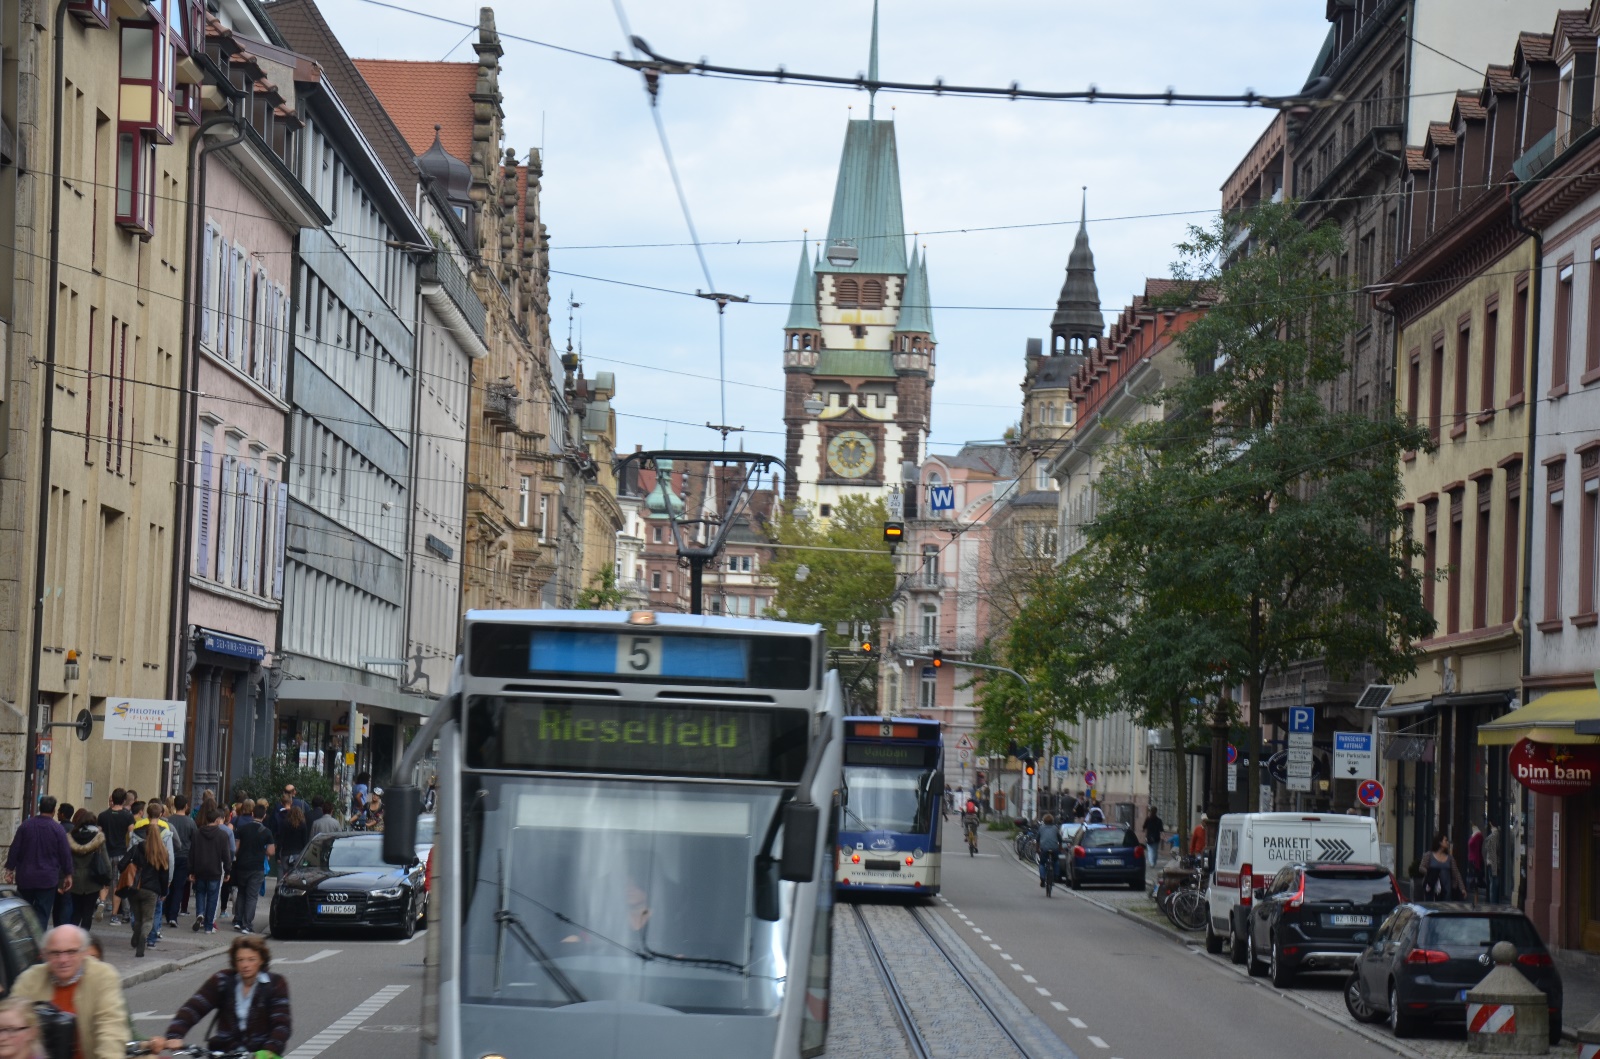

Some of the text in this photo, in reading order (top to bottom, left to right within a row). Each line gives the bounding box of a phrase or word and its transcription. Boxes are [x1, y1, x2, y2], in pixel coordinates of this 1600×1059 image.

[931, 489, 953, 507] W
[628, 637, 651, 671] 5
[112, 702, 165, 716] SPIELOTHEK
[1294, 709, 1309, 730] P
[537, 708, 739, 748] Rieselfeld
[882, 725, 890, 736] 3
[1056, 757, 1066, 769] P
[1517, 763, 1592, 780] bim bam
[1263, 837, 1311, 849] PARKETT
[1268, 849, 1312, 861] GALERIE
